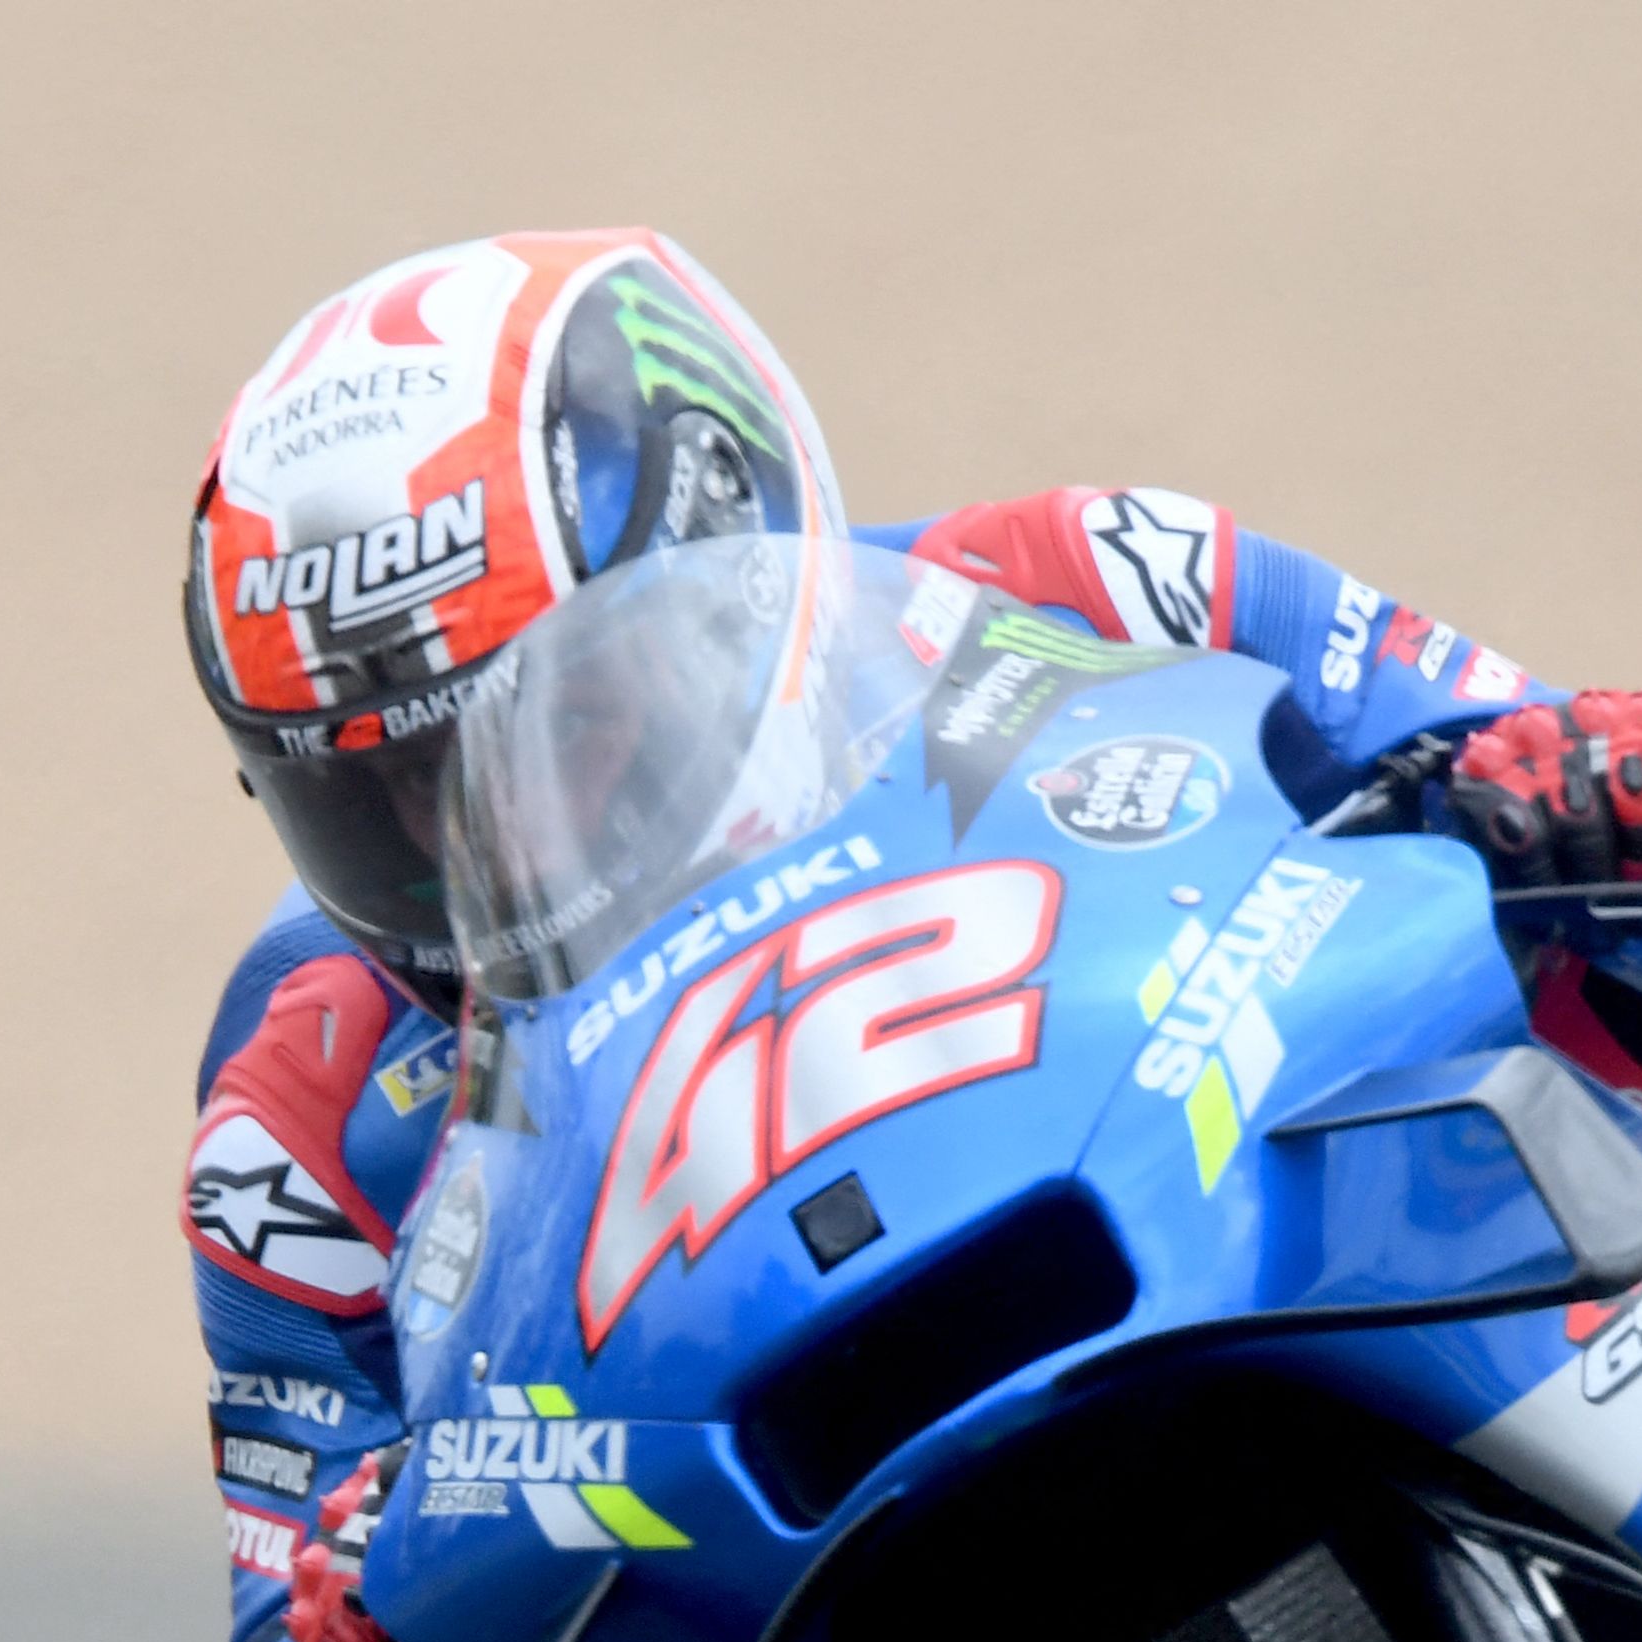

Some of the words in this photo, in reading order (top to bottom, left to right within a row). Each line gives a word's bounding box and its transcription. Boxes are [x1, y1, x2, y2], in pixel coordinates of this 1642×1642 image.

[234, 474, 485, 632] NOLAN
[566, 834, 883, 1066] SUZUKI
[1133, 856, 1333, 1097] SUZUKI
[574, 856, 1066, 1362] 42
[424, 1418, 627, 1482] SUZUKI
